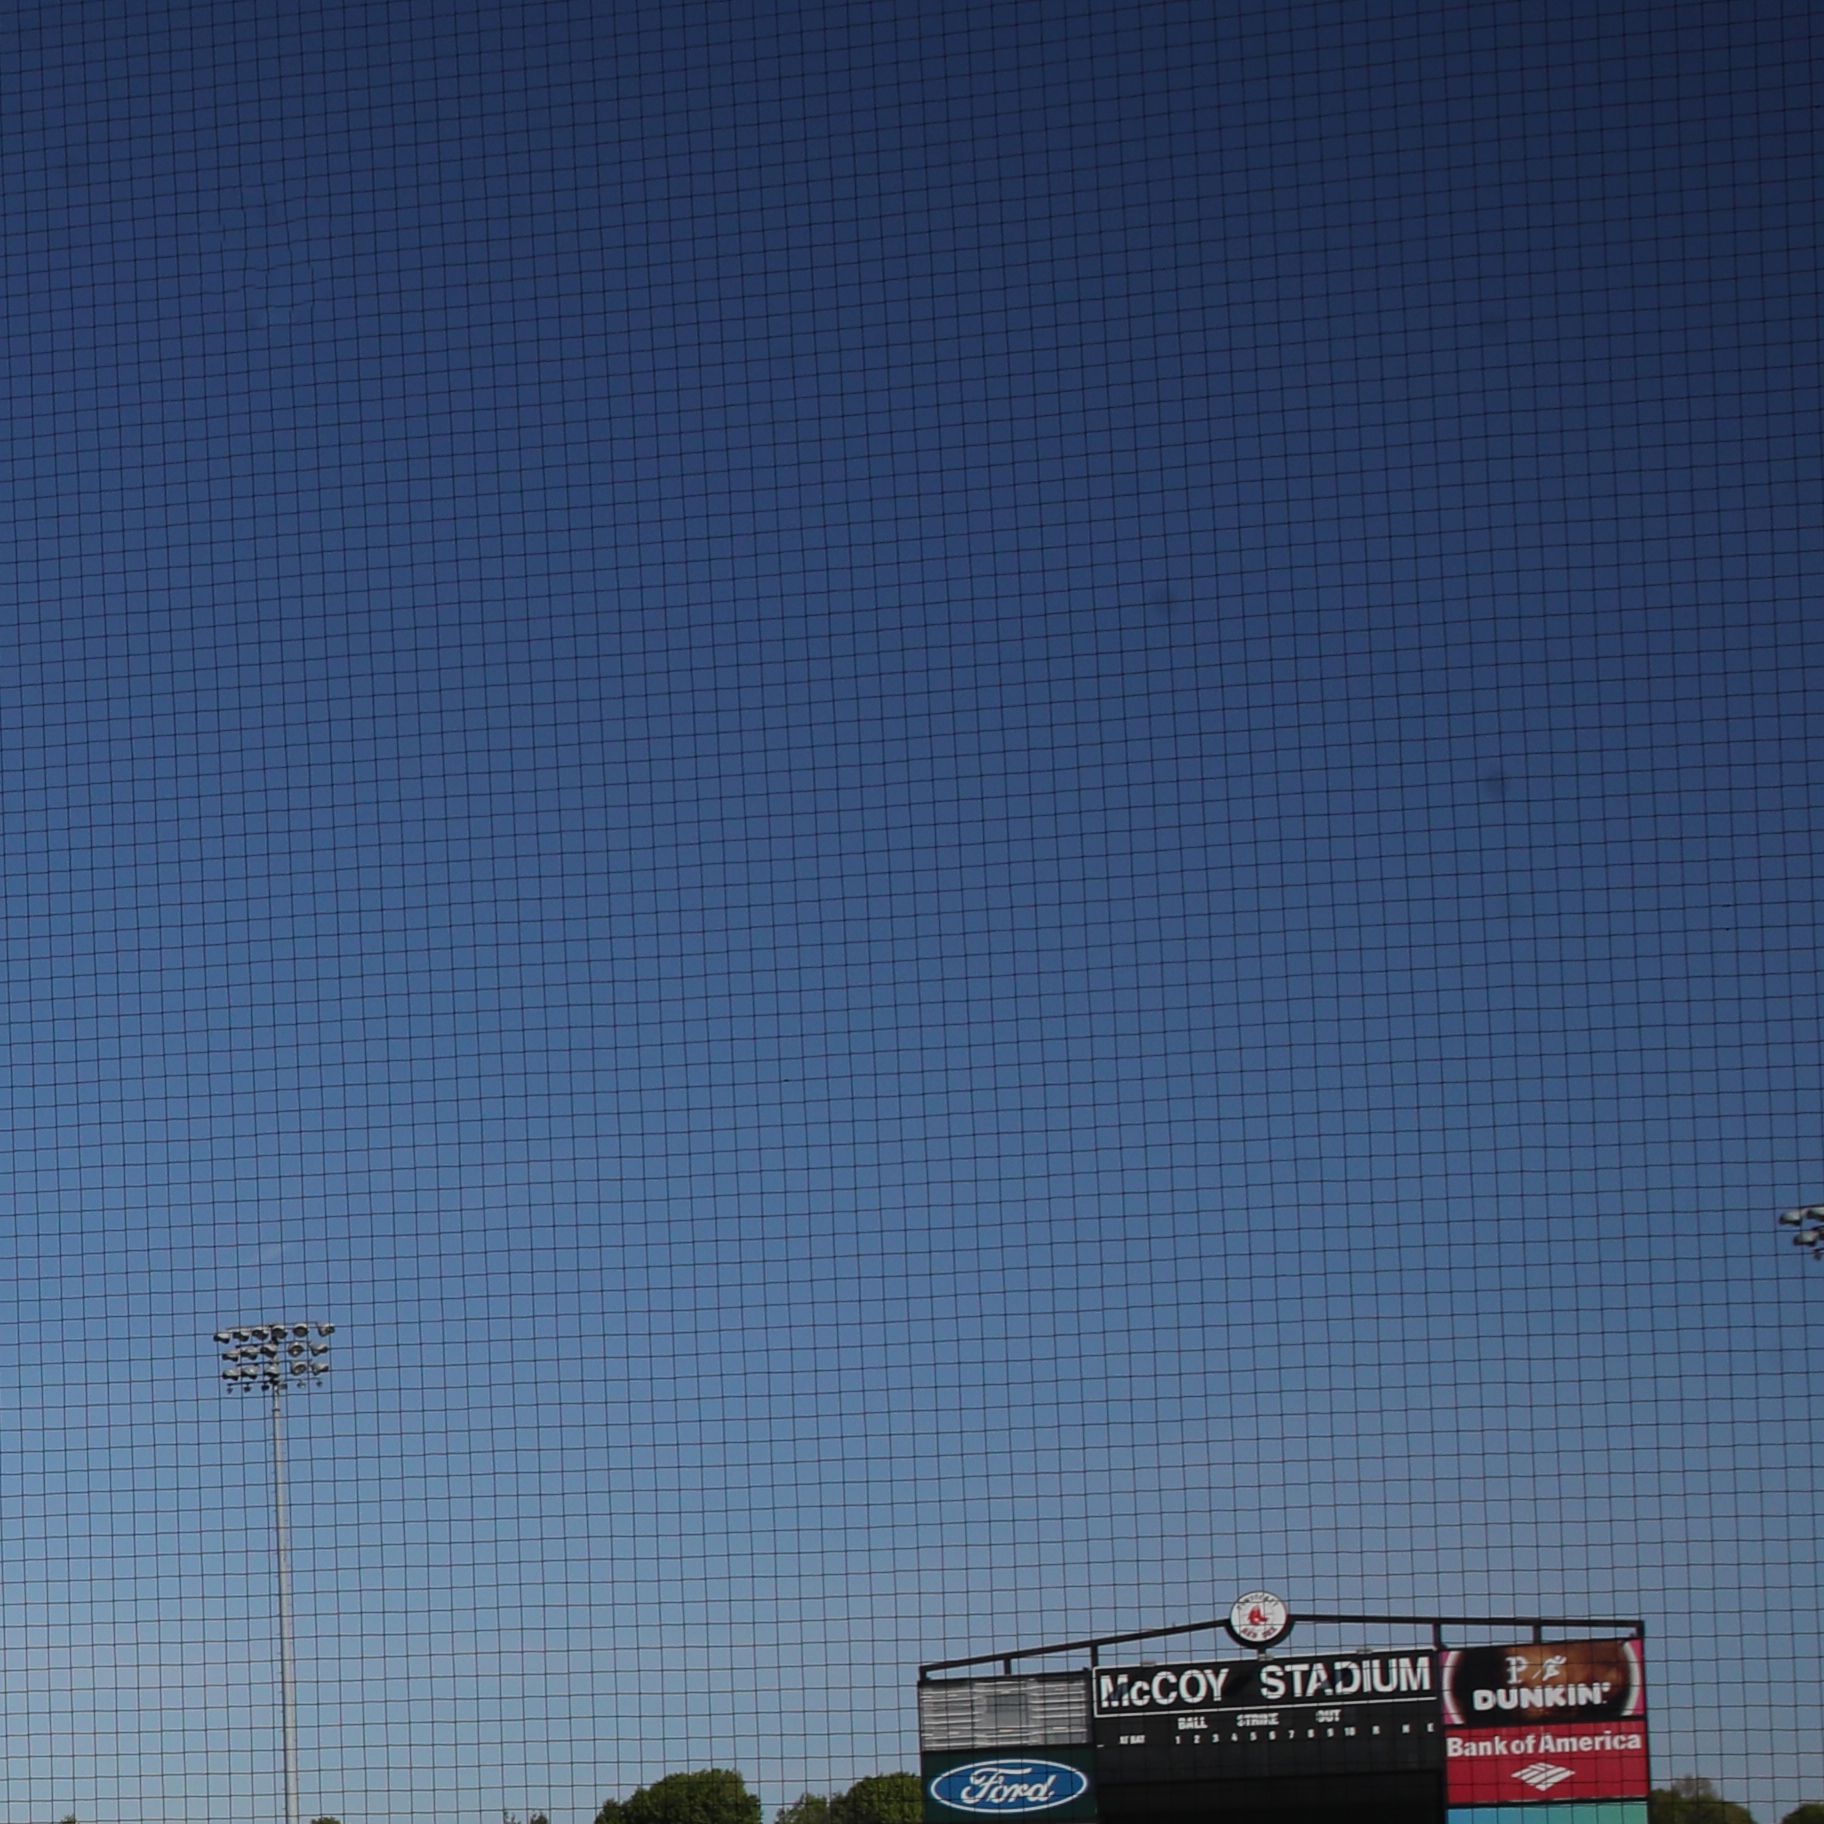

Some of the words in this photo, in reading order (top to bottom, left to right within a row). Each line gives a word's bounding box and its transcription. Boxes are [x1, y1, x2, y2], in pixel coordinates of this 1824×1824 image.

[1100, 1667, 1230, 1709] McCOY
[1260, 1656, 1431, 1700] STADIUM
[1472, 1682, 1612, 1711] DUNKIN'
[1178, 1715, 1208, 1730] BALL
[1236, 1713, 1280, 1728] STRIKE
[1315, 1709, 1342, 1724] OUT
[1194, 1734, 1201, 1744] 2
[1446, 1736, 1509, 1757] Bank
[1510, 1733, 1537, 1754] of
[1538, 1730, 1642, 1754] America
[960, 1767, 1057, 1805] Ford
